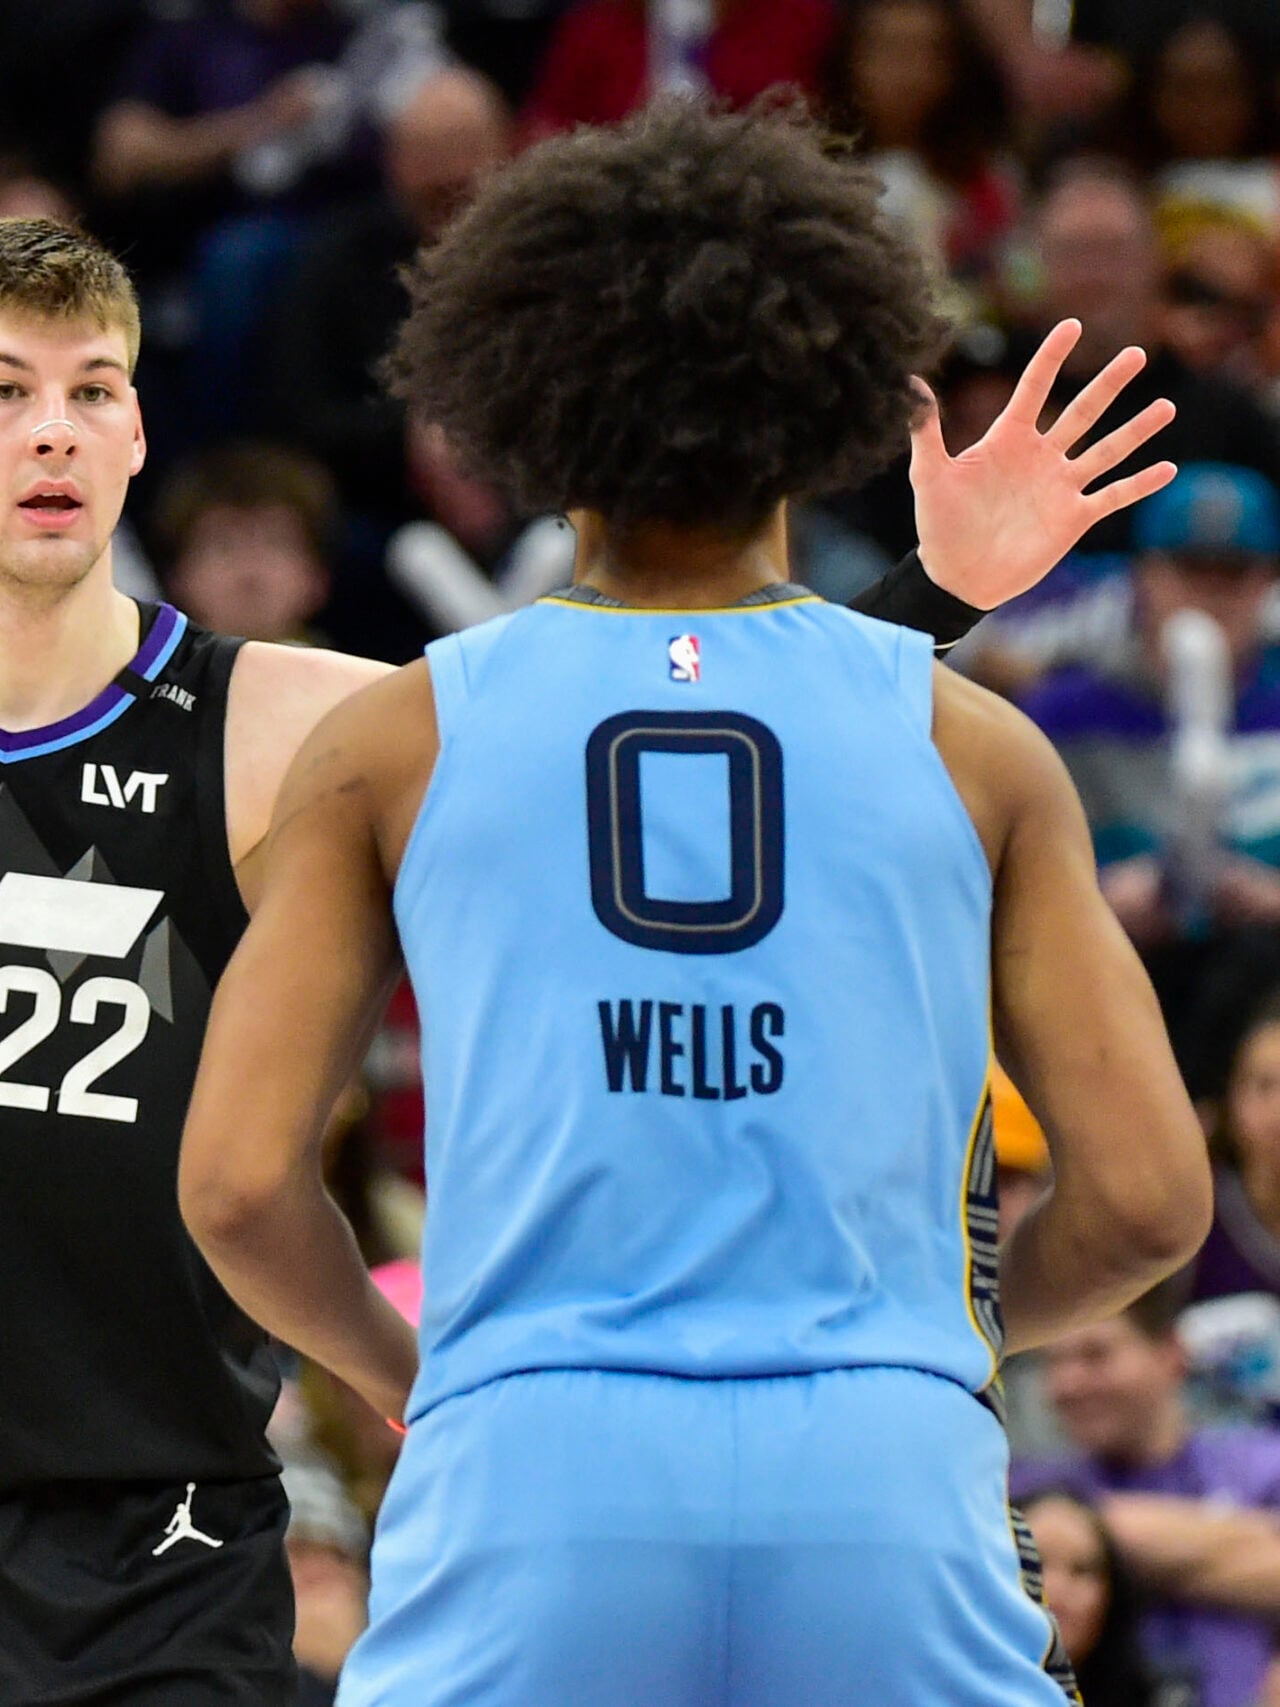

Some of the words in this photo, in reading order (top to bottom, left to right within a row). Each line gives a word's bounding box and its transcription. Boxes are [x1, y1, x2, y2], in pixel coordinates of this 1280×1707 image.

[81, 763, 170, 813] LVT
[585, 710, 786, 955] 0
[598, 998, 785, 1101] WELLS
